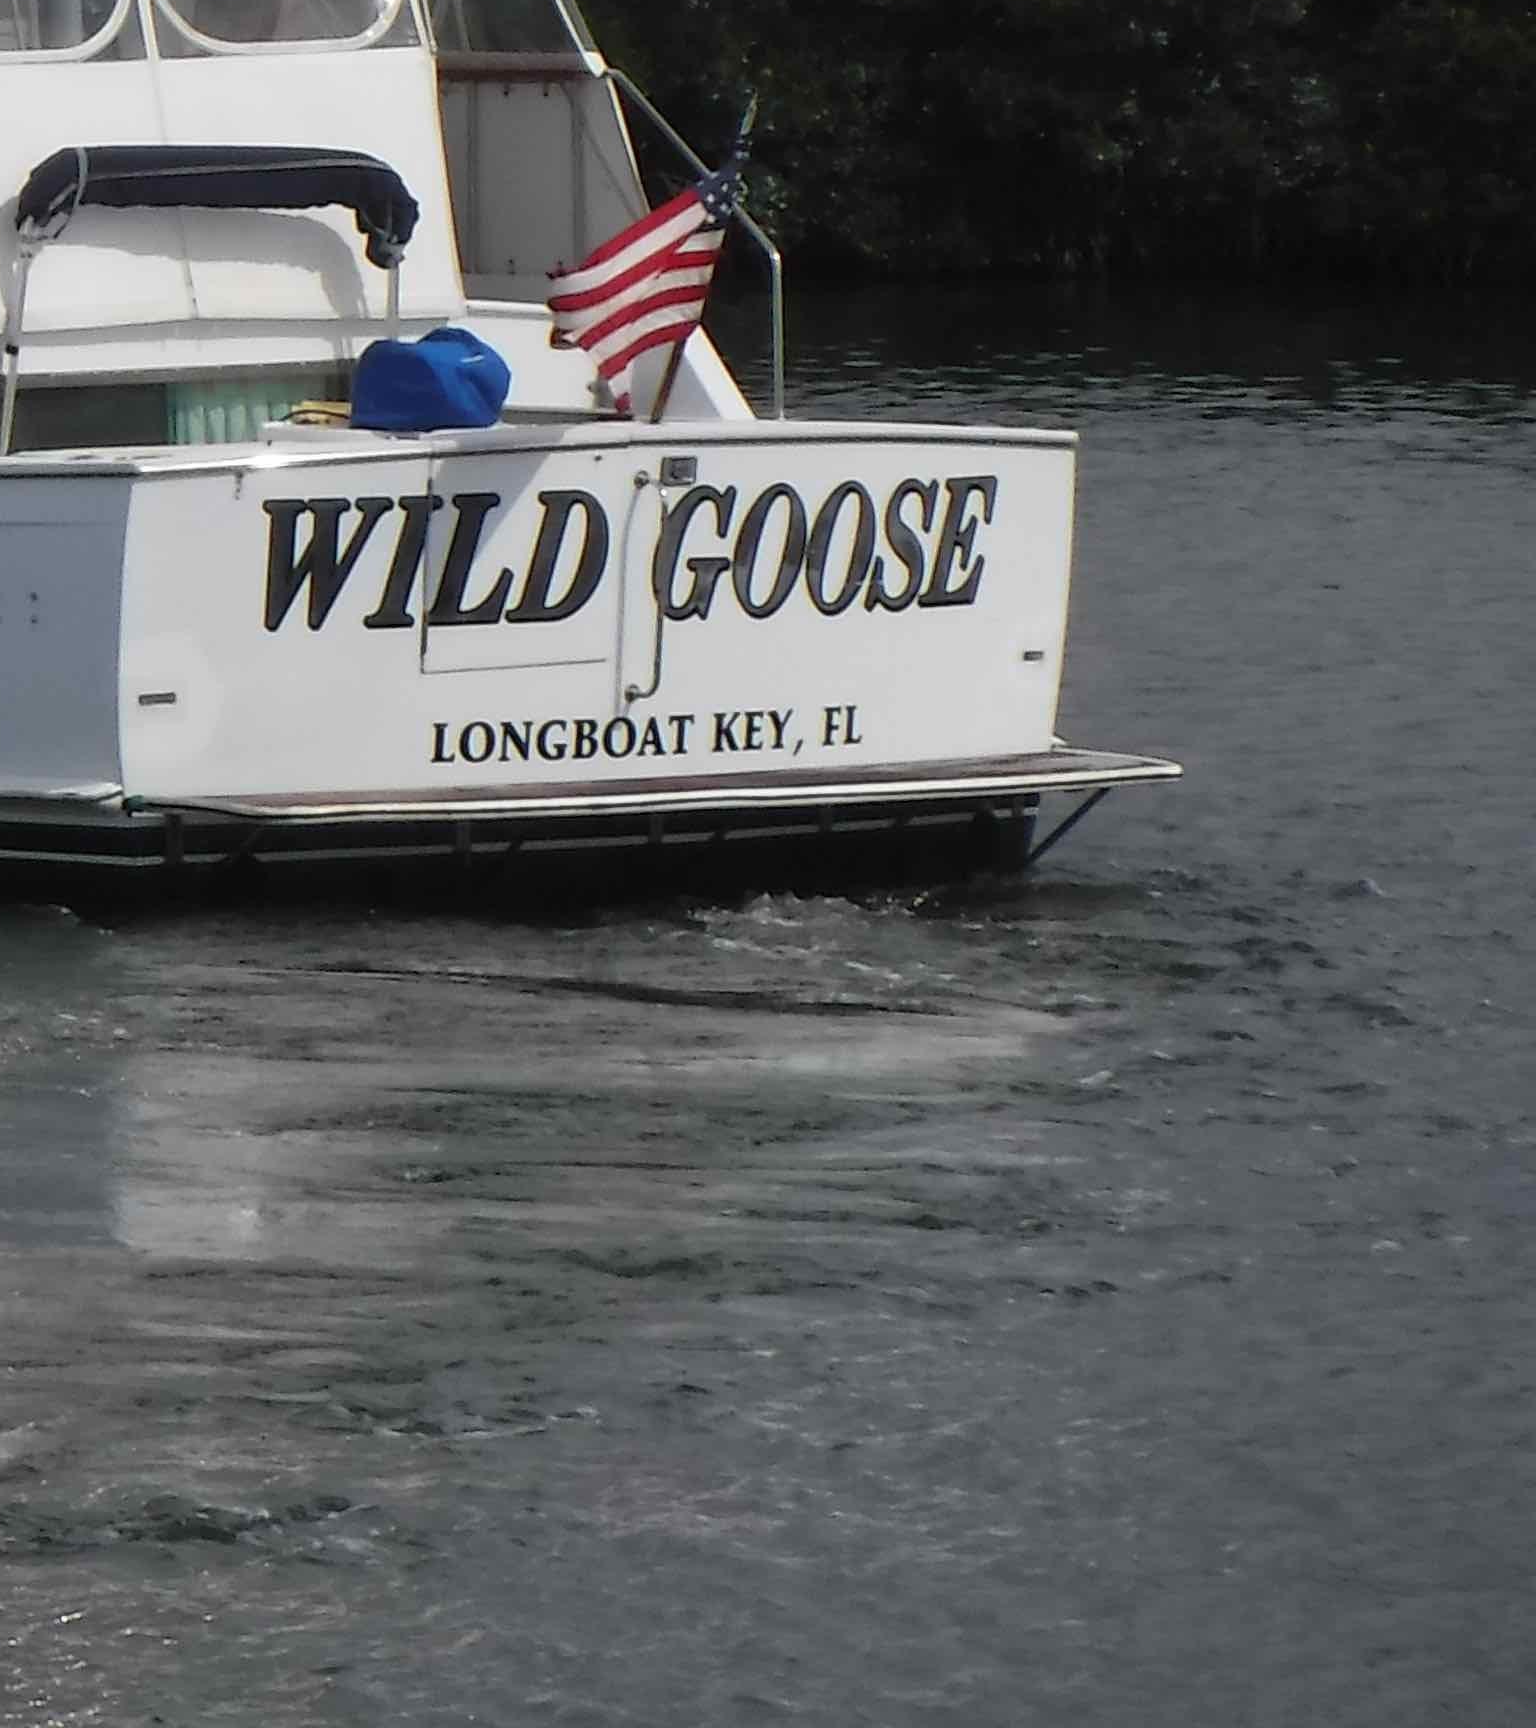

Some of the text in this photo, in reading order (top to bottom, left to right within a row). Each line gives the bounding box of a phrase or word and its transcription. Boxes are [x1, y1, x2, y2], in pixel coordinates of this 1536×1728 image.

[263, 475, 998, 632] WILD GOOSE
[431, 706, 863, 763] LONGBOAT KEY, FL
